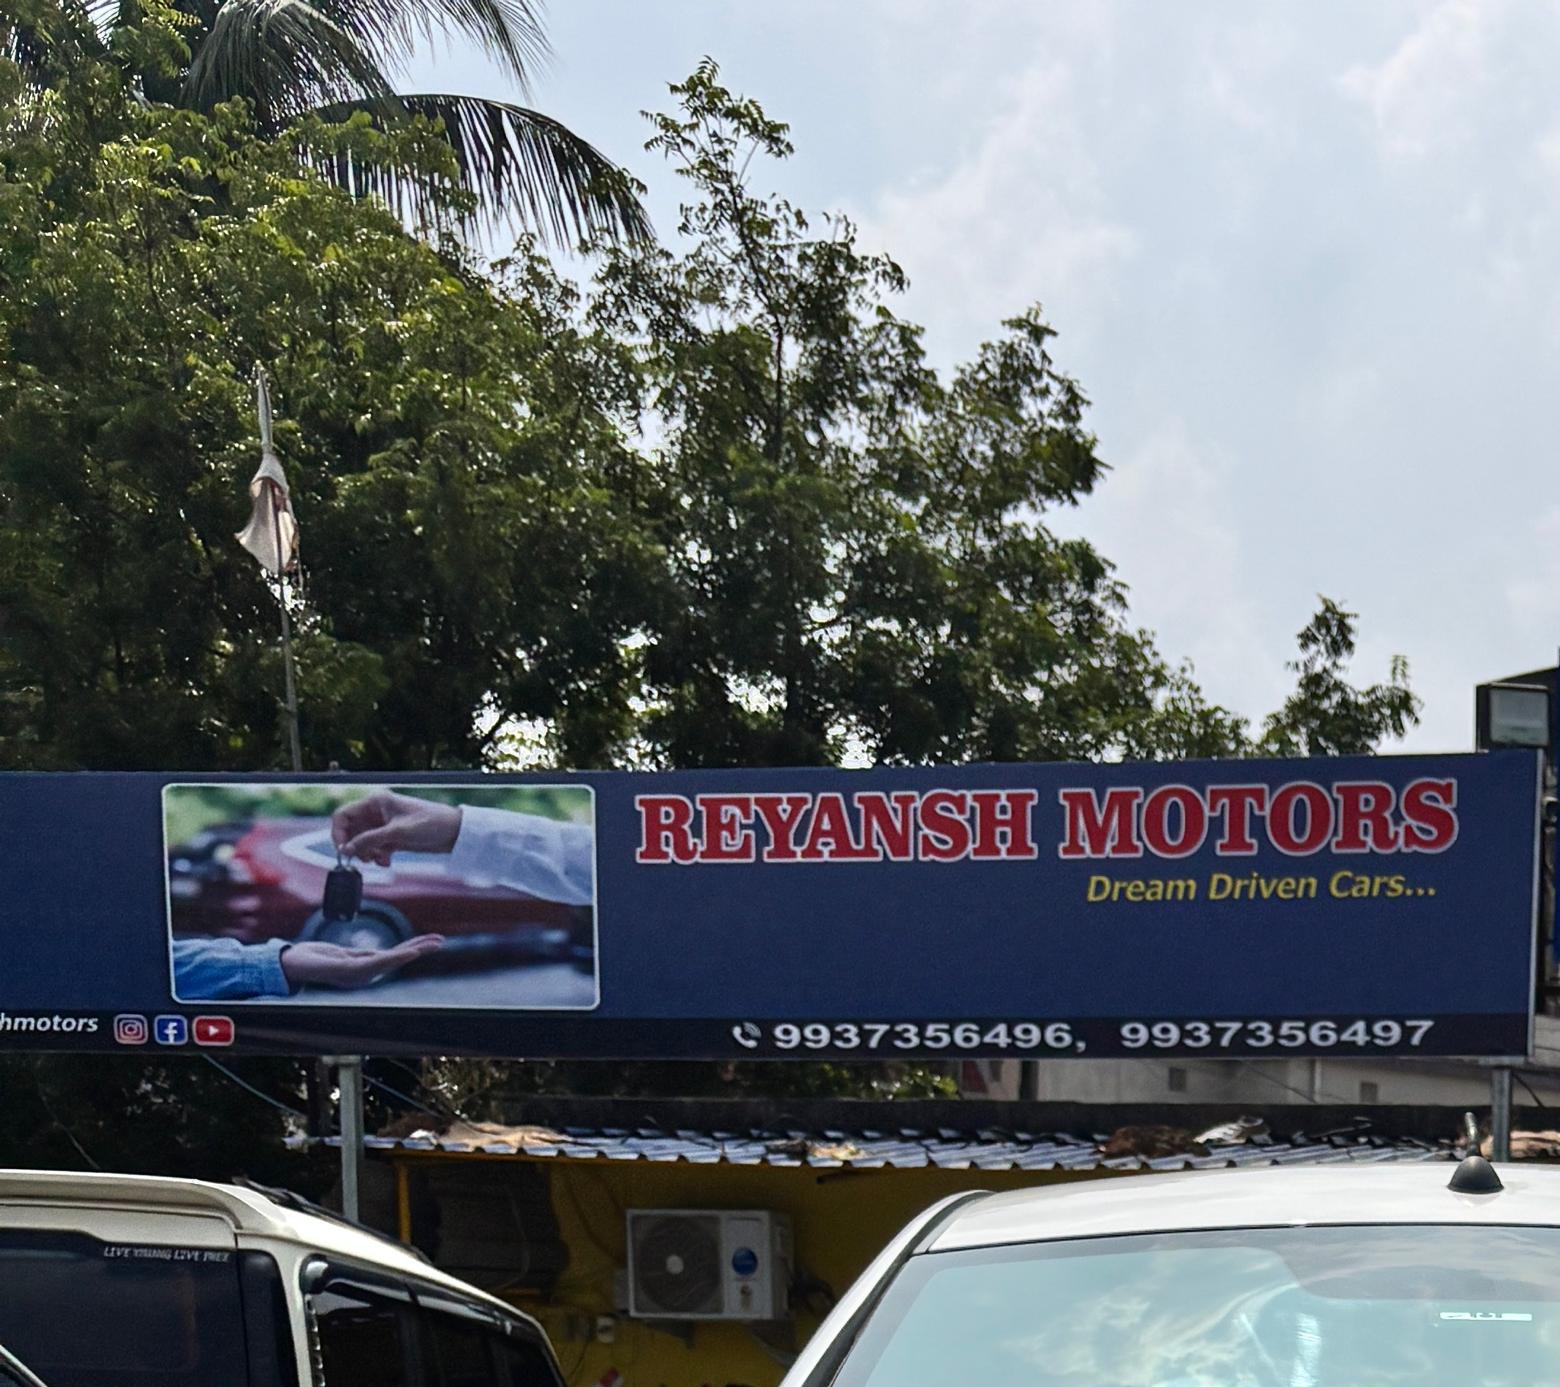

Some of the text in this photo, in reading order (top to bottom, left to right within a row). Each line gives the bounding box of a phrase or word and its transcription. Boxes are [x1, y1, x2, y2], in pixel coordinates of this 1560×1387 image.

[635, 778, 1459, 864] REYANSH MOTORS
[1087, 871, 1436, 901] Dream Driven Cars...
[773, 1020, 1435, 1052] 9937356496, 9937356497
